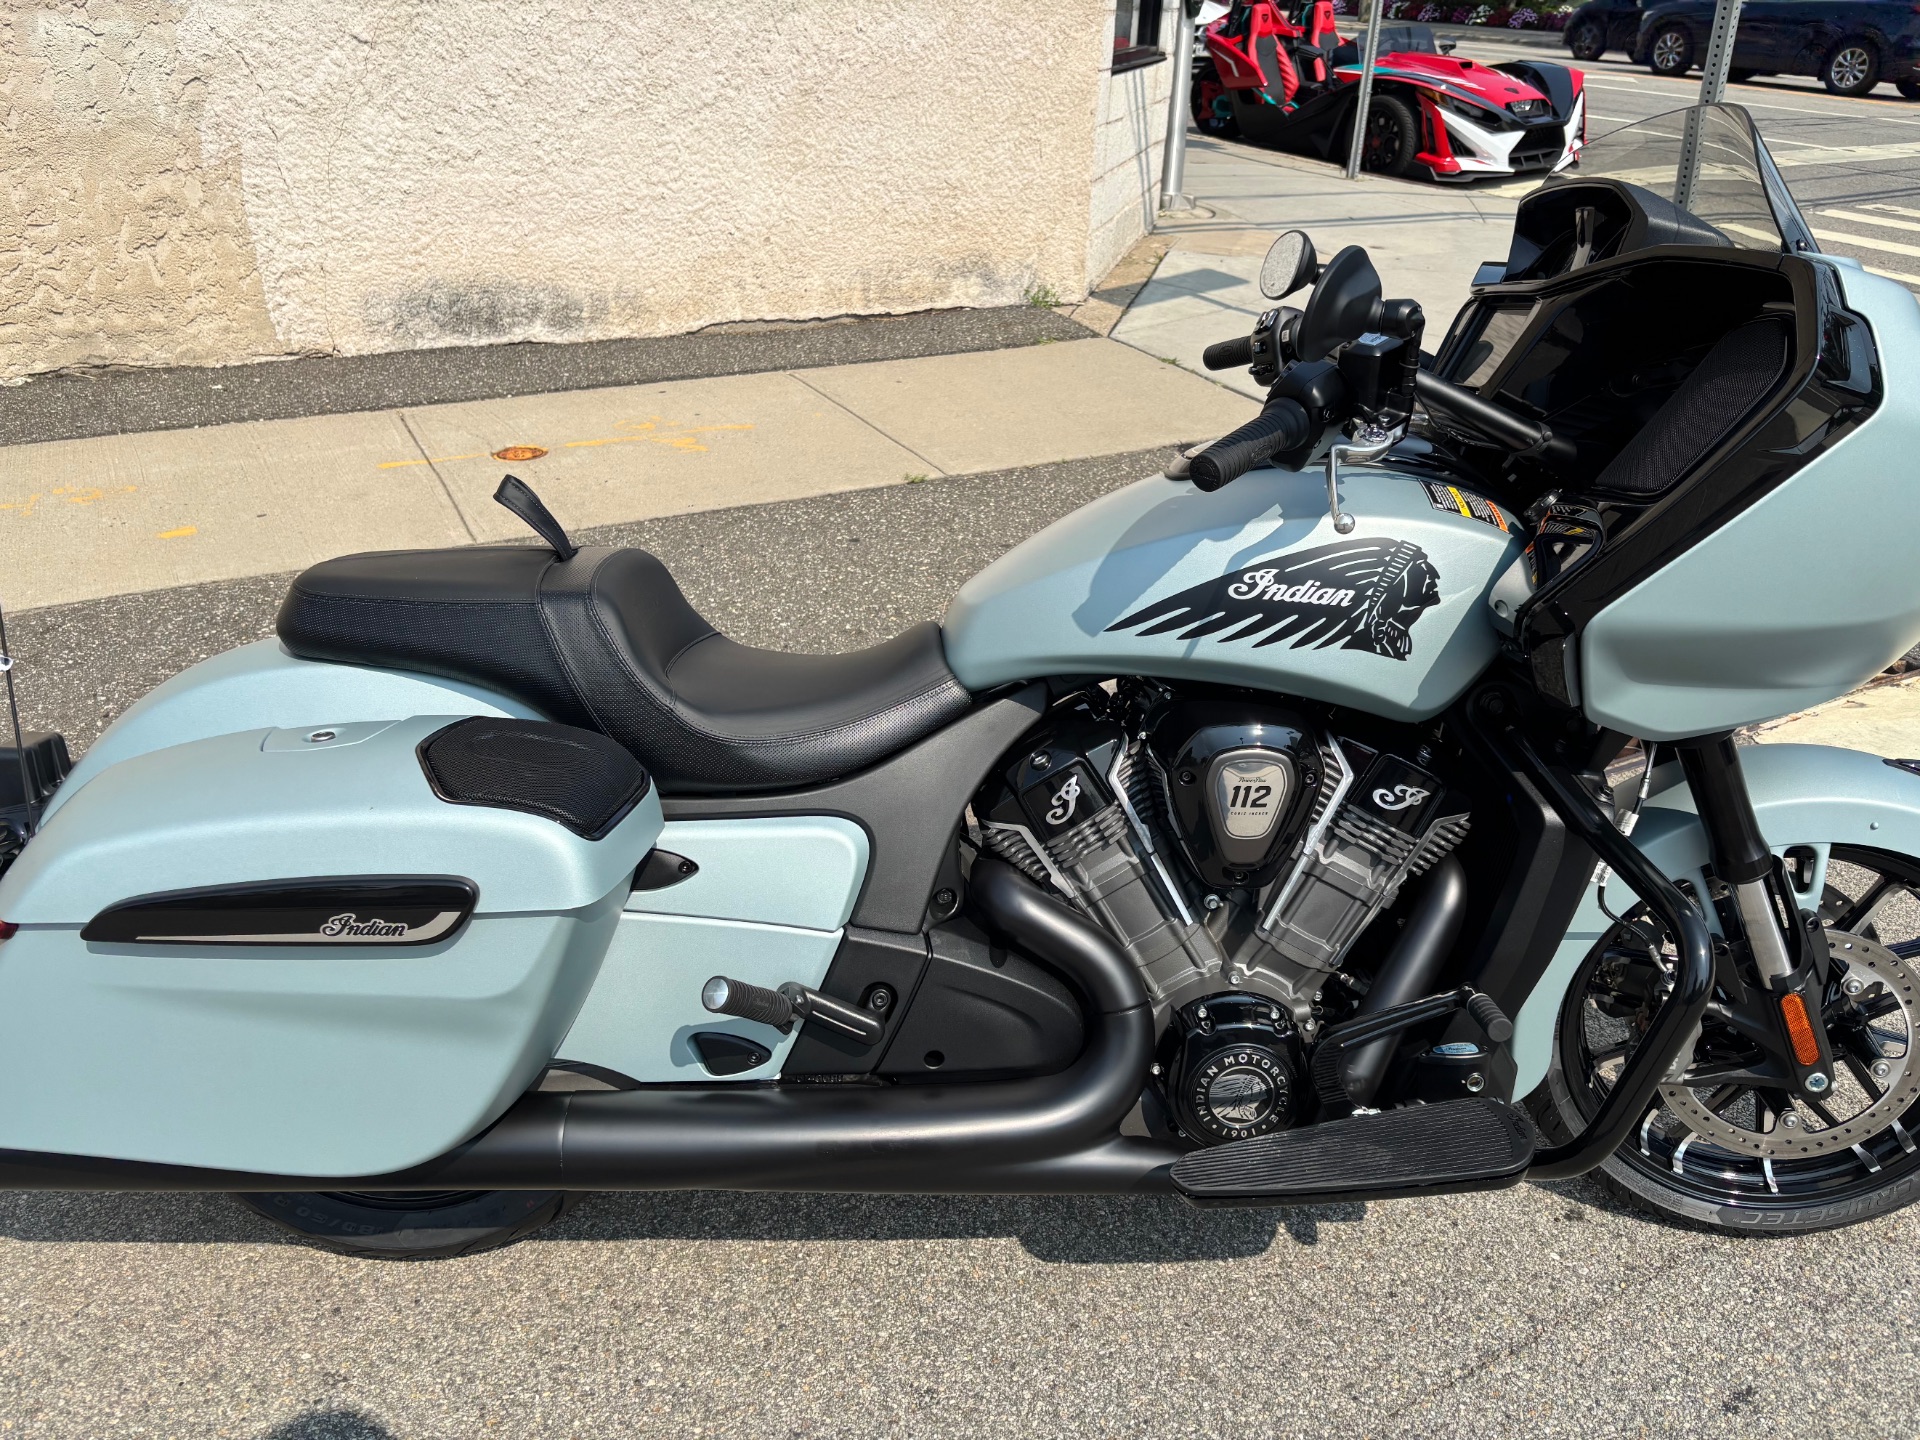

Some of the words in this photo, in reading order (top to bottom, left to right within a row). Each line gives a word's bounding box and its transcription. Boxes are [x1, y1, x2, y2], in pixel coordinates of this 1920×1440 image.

[1227, 568, 1356, 608] Indian
[1230, 785, 1272, 808] 112
[320, 913, 407, 937] Indian
[1195, 1065, 1219, 1122] INDIAN
[1222, 1127, 1257, 1138] 1901
[1739, 1178, 1914, 1226] CRUISETEC
